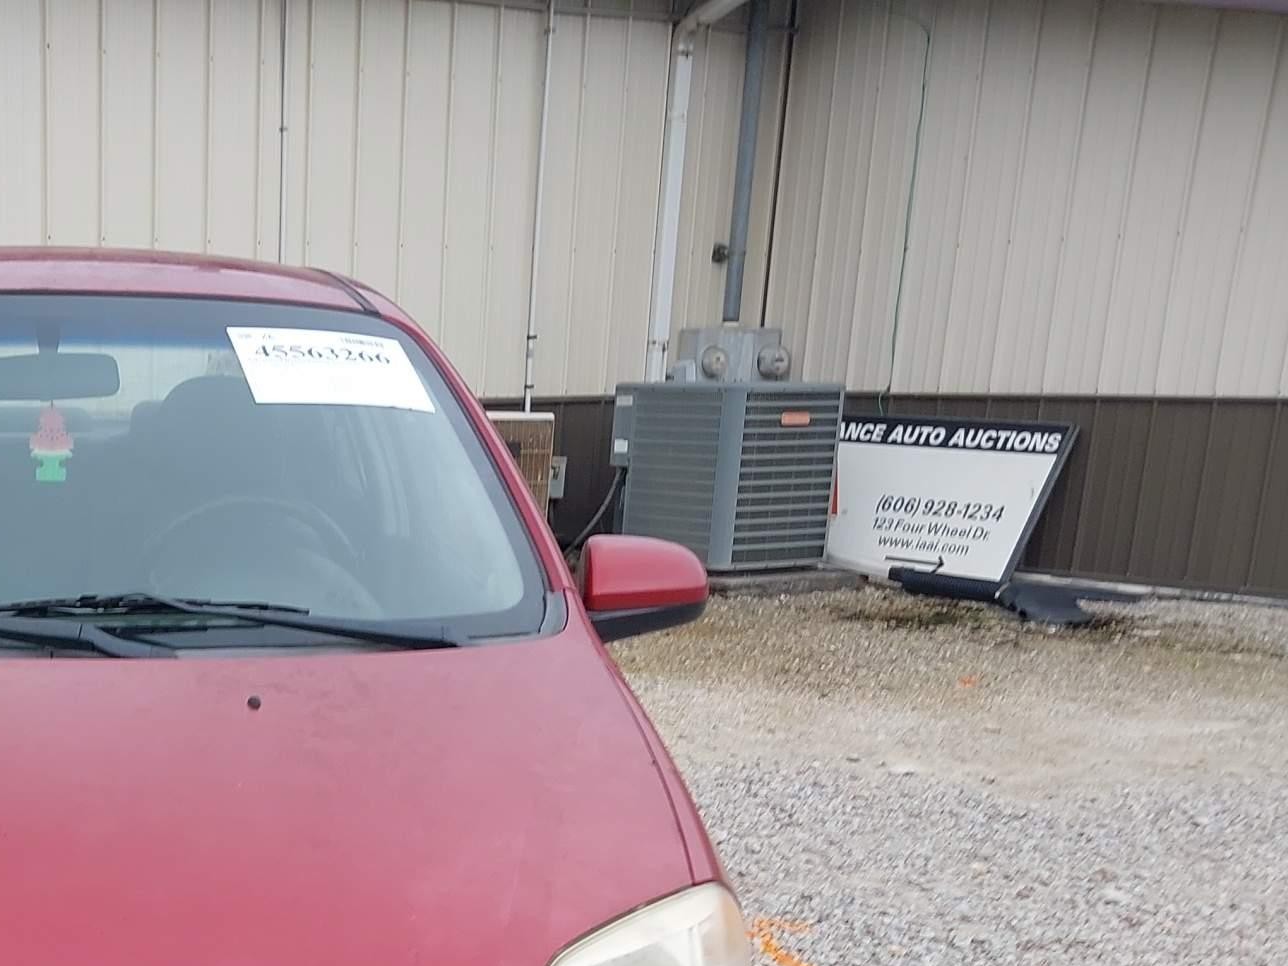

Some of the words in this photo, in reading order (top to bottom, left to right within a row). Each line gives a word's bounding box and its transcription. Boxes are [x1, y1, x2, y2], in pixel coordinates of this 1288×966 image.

[255, 345, 391, 365] 45563266
[887, 424, 947, 446] AUTO
[948, 427, 1063, 453] AUCTIONS
[875, 494, 922, 518] (606)
[922, 499, 1005, 523] 928-1234
[873, 516, 895, 531] 123
[894, 518, 927, 534] Four
[926, 521, 972, 538] Wheel
[878, 535, 970, 557] www.iaai.com
